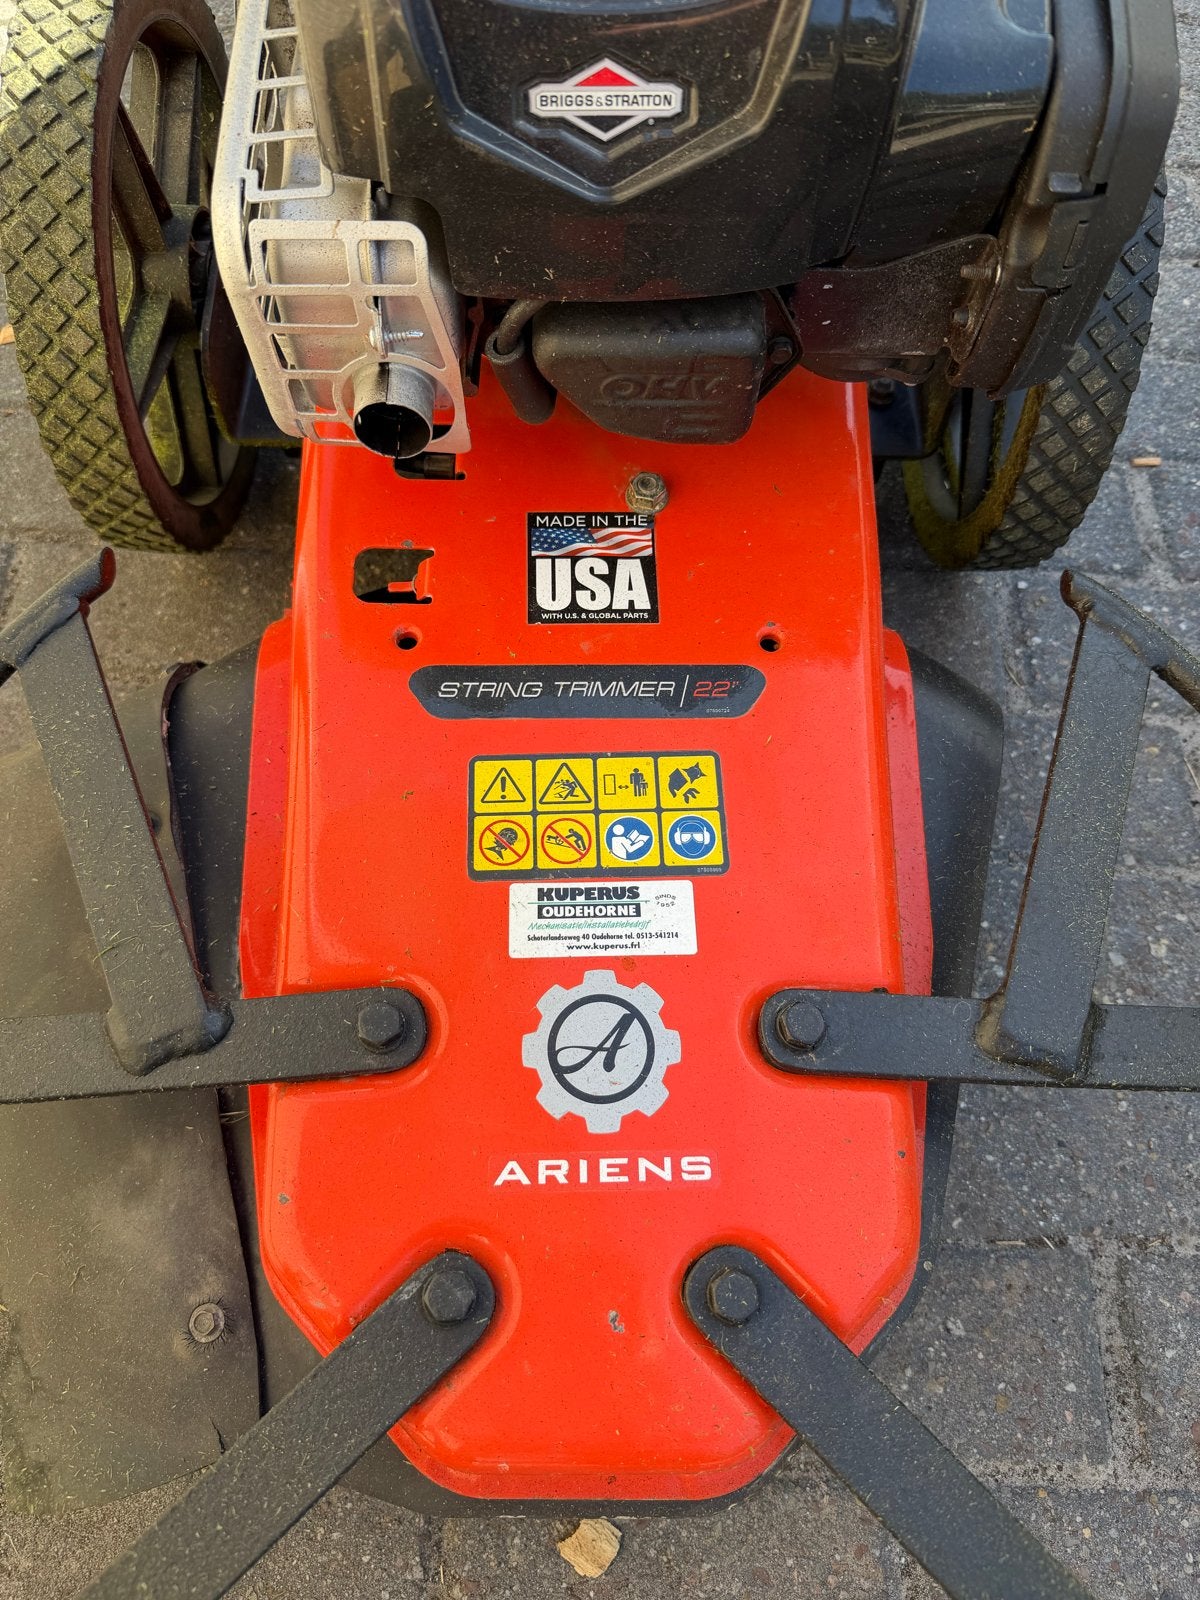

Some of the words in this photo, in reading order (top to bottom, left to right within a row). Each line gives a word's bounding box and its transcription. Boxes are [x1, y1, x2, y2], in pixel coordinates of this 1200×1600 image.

[536, 515, 586, 527] MADE
[592, 515, 608, 527] IN
[614, 514, 648, 526] THE
[536, 557, 651, 611] USA
[438, 681, 543, 698] STRING
[554, 681, 676, 697] TRIMMER
[537, 886, 640, 902] KUPERUS
[542, 904, 637, 918] OUDEHORNE
[636, 931, 679, 939] 0513-541214
[566, 942, 641, 951] www.kuperus.frl
[494, 1156, 712, 1187] ARIENS
